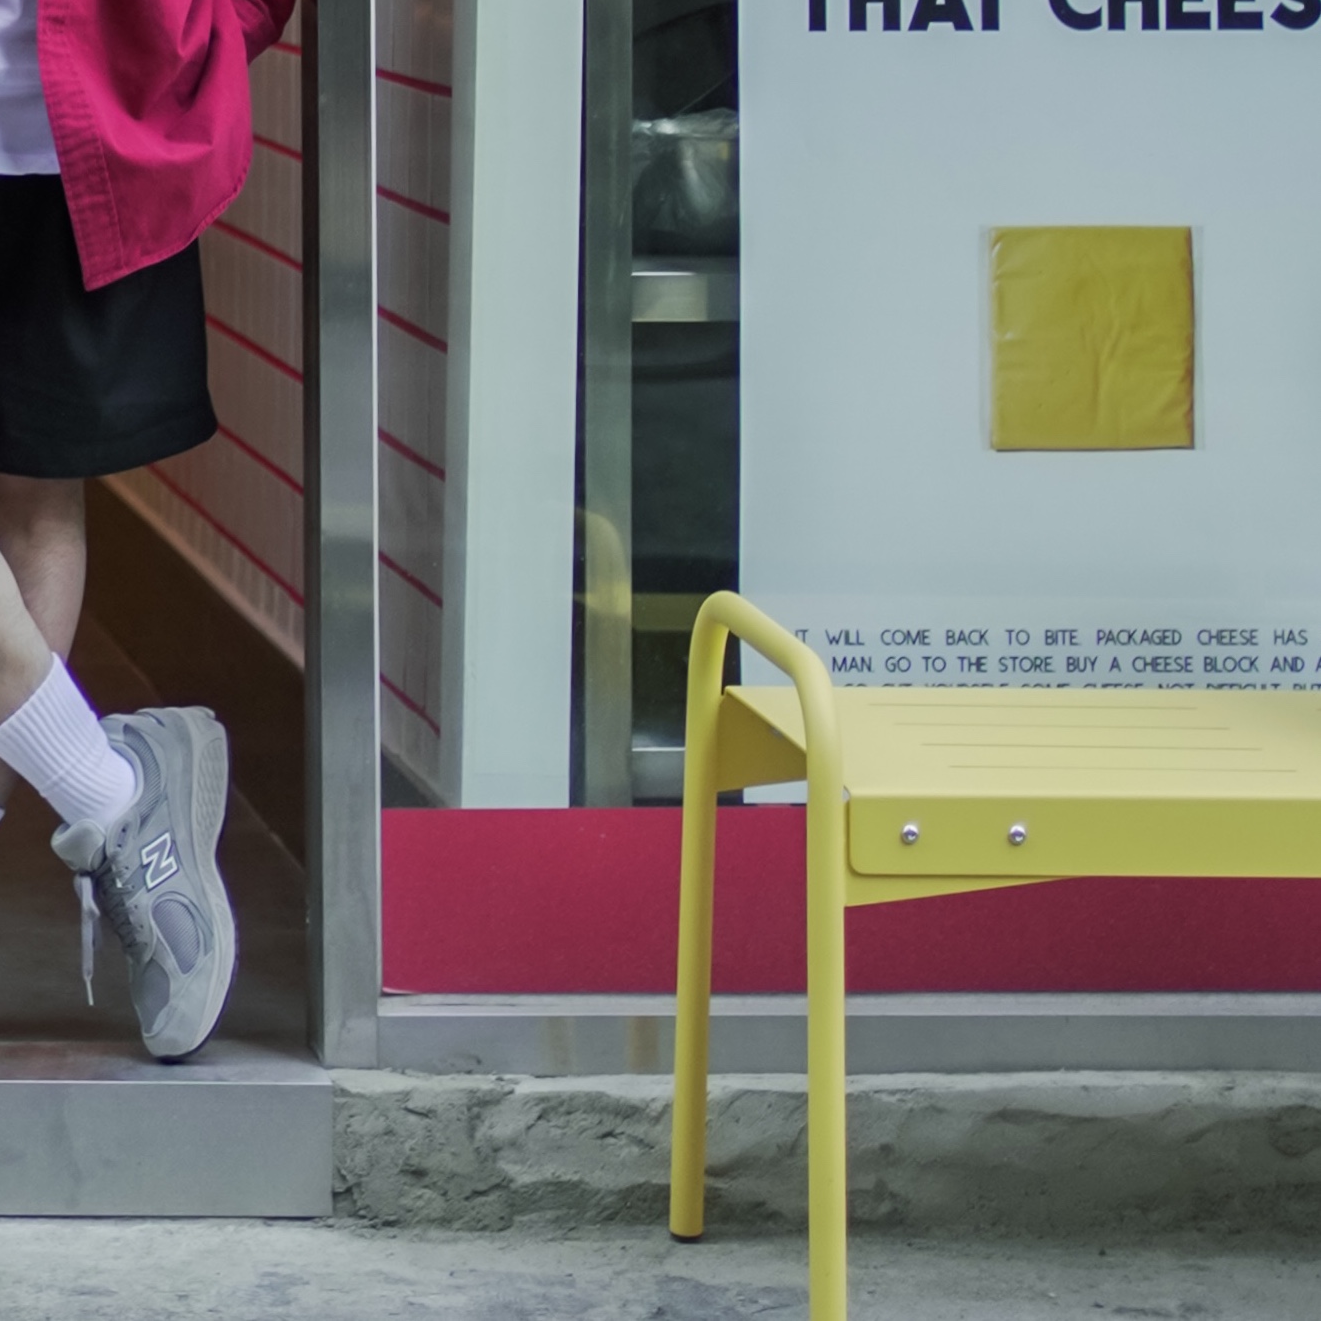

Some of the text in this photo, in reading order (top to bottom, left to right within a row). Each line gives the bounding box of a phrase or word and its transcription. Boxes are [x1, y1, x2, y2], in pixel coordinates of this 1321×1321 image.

[824, 629, 865, 646] WILL
[880, 629, 931, 646] COME
[945, 629, 989, 646] BACK
[1005, 629, 1030, 646] TO
[1095, 629, 1183, 646] PACKAGED
[1196, 629, 1259, 646] CHEESE
[1273, 629, 1309, 646] HAS
[884, 656, 912, 673] GO
[921, 656, 947, 673] TO
[956, 656, 988, 673] THE
[1065, 656, 1099, 673] BUY
[1108, 656, 1123, 673] A
[1131, 656, 1194, 673] CHEESE
[1202, 656, 1260, 673] BLOCK
[1269, 656, 1306, 673] AND
[140, 830, 178, 890] N
